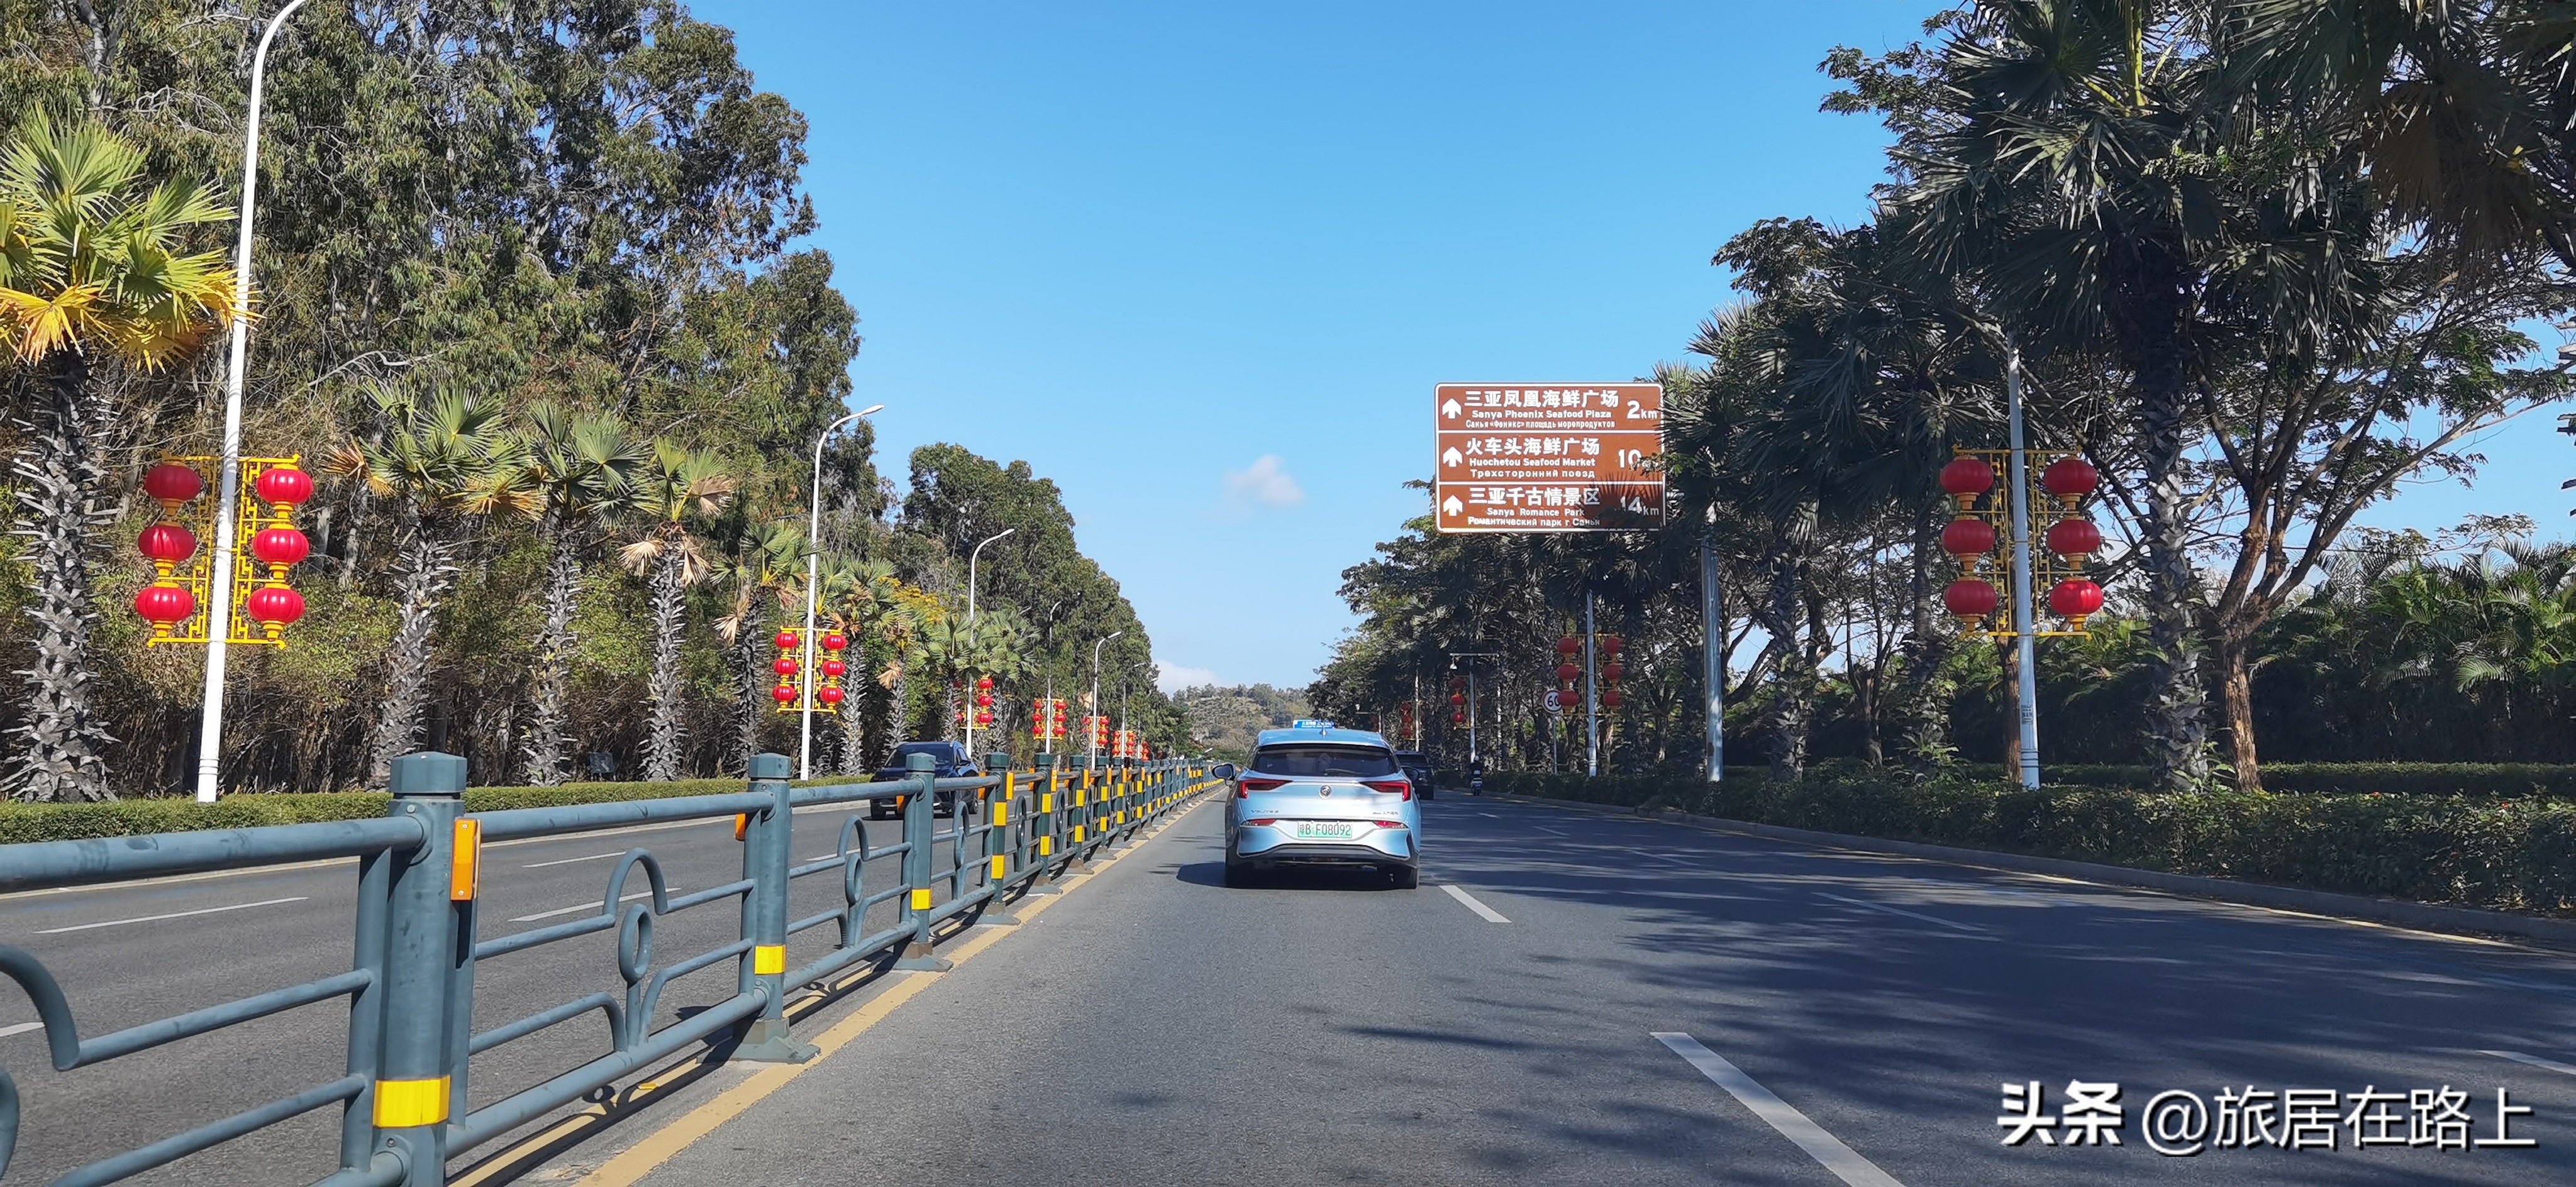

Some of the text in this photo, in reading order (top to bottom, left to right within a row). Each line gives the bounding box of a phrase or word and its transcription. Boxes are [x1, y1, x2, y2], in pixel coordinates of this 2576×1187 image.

[1464, 390, 1619, 408] 三亚凤凰海鲜广场
[1472, 410, 1612, 419] Sanya Phoenix Seafood Plaza
[1466, 420, 1489, 428] Санья
[1465, 437, 1599, 456] 火车头海鲜广场
[1469, 458, 1596, 467] Huochetou Seafood Market
[1562, 470, 1596, 478] поезд
[1468, 487, 1600, 506] 三亚千古情景区
[1487, 507, 1585, 518] Sanya Romance Park
[1467, 516, 1537, 526] Романтический
[1572, 517, 1601, 526] Санья
[1548, 695, 1560, 707] 60
